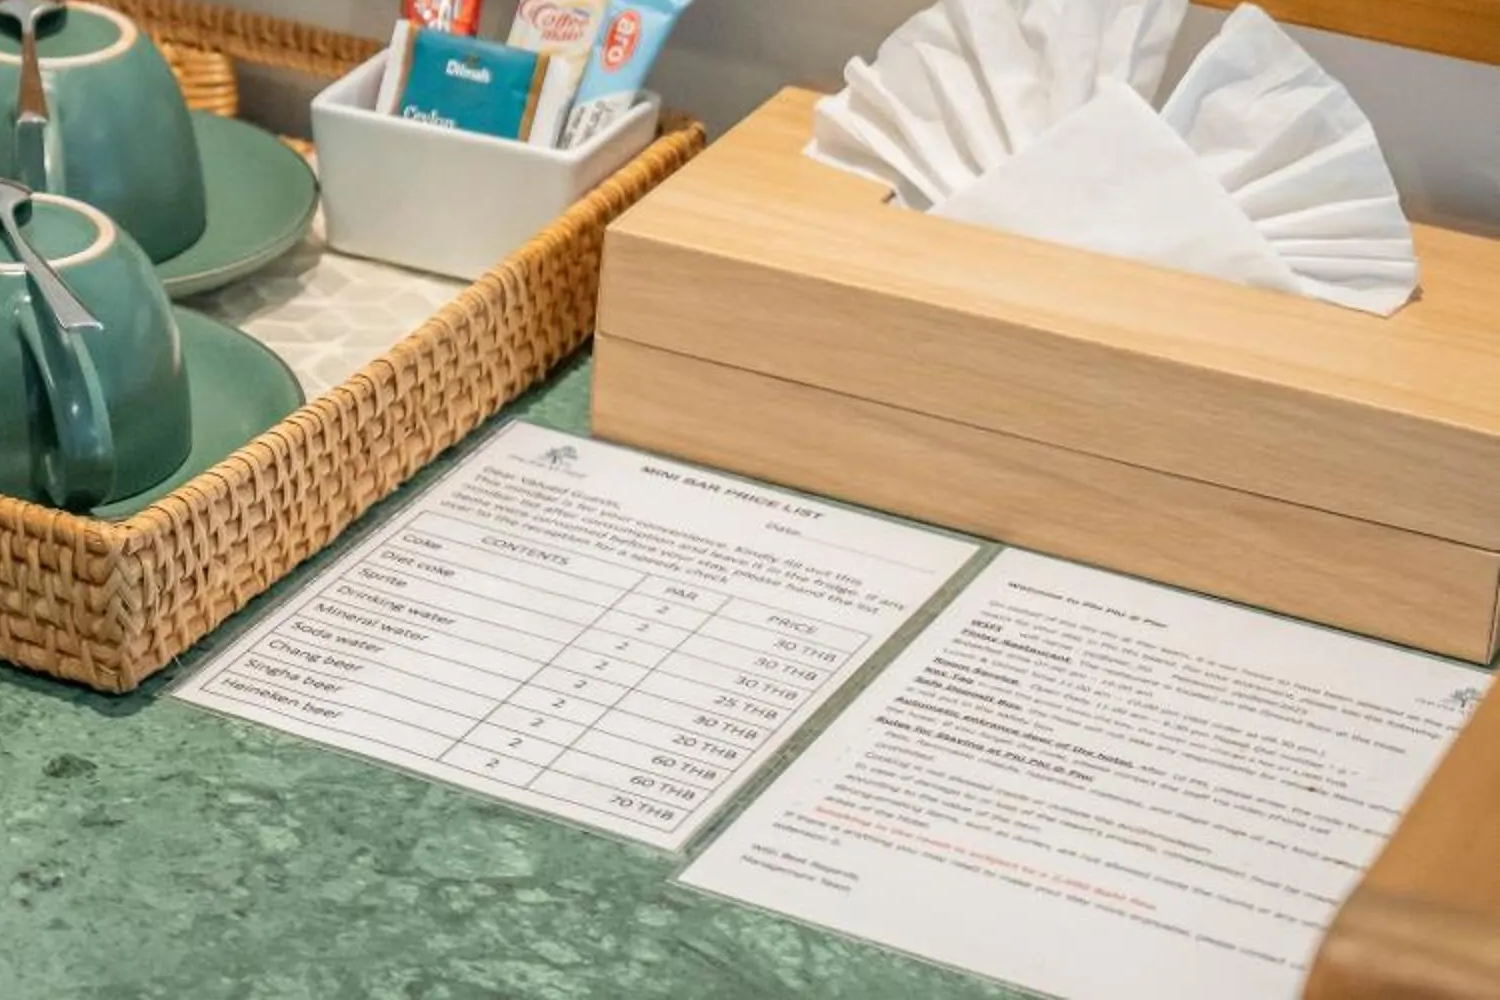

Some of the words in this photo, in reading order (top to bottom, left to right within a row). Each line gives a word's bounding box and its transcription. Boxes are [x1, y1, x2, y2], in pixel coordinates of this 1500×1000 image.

[640, 466, 680, 481] MINI
[682, 477, 721, 491] BAR
[724, 488, 780, 507] PRICE
[782, 503, 824, 519] LIST
[358, 568, 409, 587] Sprite
[615, 641, 629, 650] 2
[760, 683, 799, 700] THB
[381, 551, 415, 565] Diet
[417, 561, 457, 577] coke
[636, 622, 649, 631] 2
[780, 664, 818, 680] THB
[402, 534, 443, 549] Coke
[655, 604, 669, 613] 2
[799, 646, 836, 662] THB
[480, 535, 571, 565] CONTENTS
[767, 615, 818, 634] PRICE
[266, 638, 324, 661] Chang
[322, 655, 364, 673] beer
[531, 718, 545, 727] 2
[652, 754, 677, 768] 60
[679, 762, 718, 780] THB
[291, 621, 333, 638] Soda
[334, 634, 384, 653] water
[553, 698, 567, 707] 2
[673, 734, 698, 747] 20
[700, 742, 739, 759] THB
[315, 604, 379, 626] Mineral
[379, 622, 428, 641] water
[573, 679, 587, 689] 2
[720, 722, 759, 739] THB
[335, 585, 407, 611] Drinking
[406, 605, 457, 626] water
[594, 660, 608, 669] 2
[740, 702, 779, 719] THB
[221, 678, 300, 706] Heineken
[302, 702, 342, 719] beer
[487, 758, 501, 768] 2
[637, 803, 676, 821] THB
[244, 659, 303, 681] Singha
[302, 676, 343, 694] beer
[509, 737, 524, 748] 2
[631, 775, 656, 788] 60
[658, 783, 697, 800] THB
